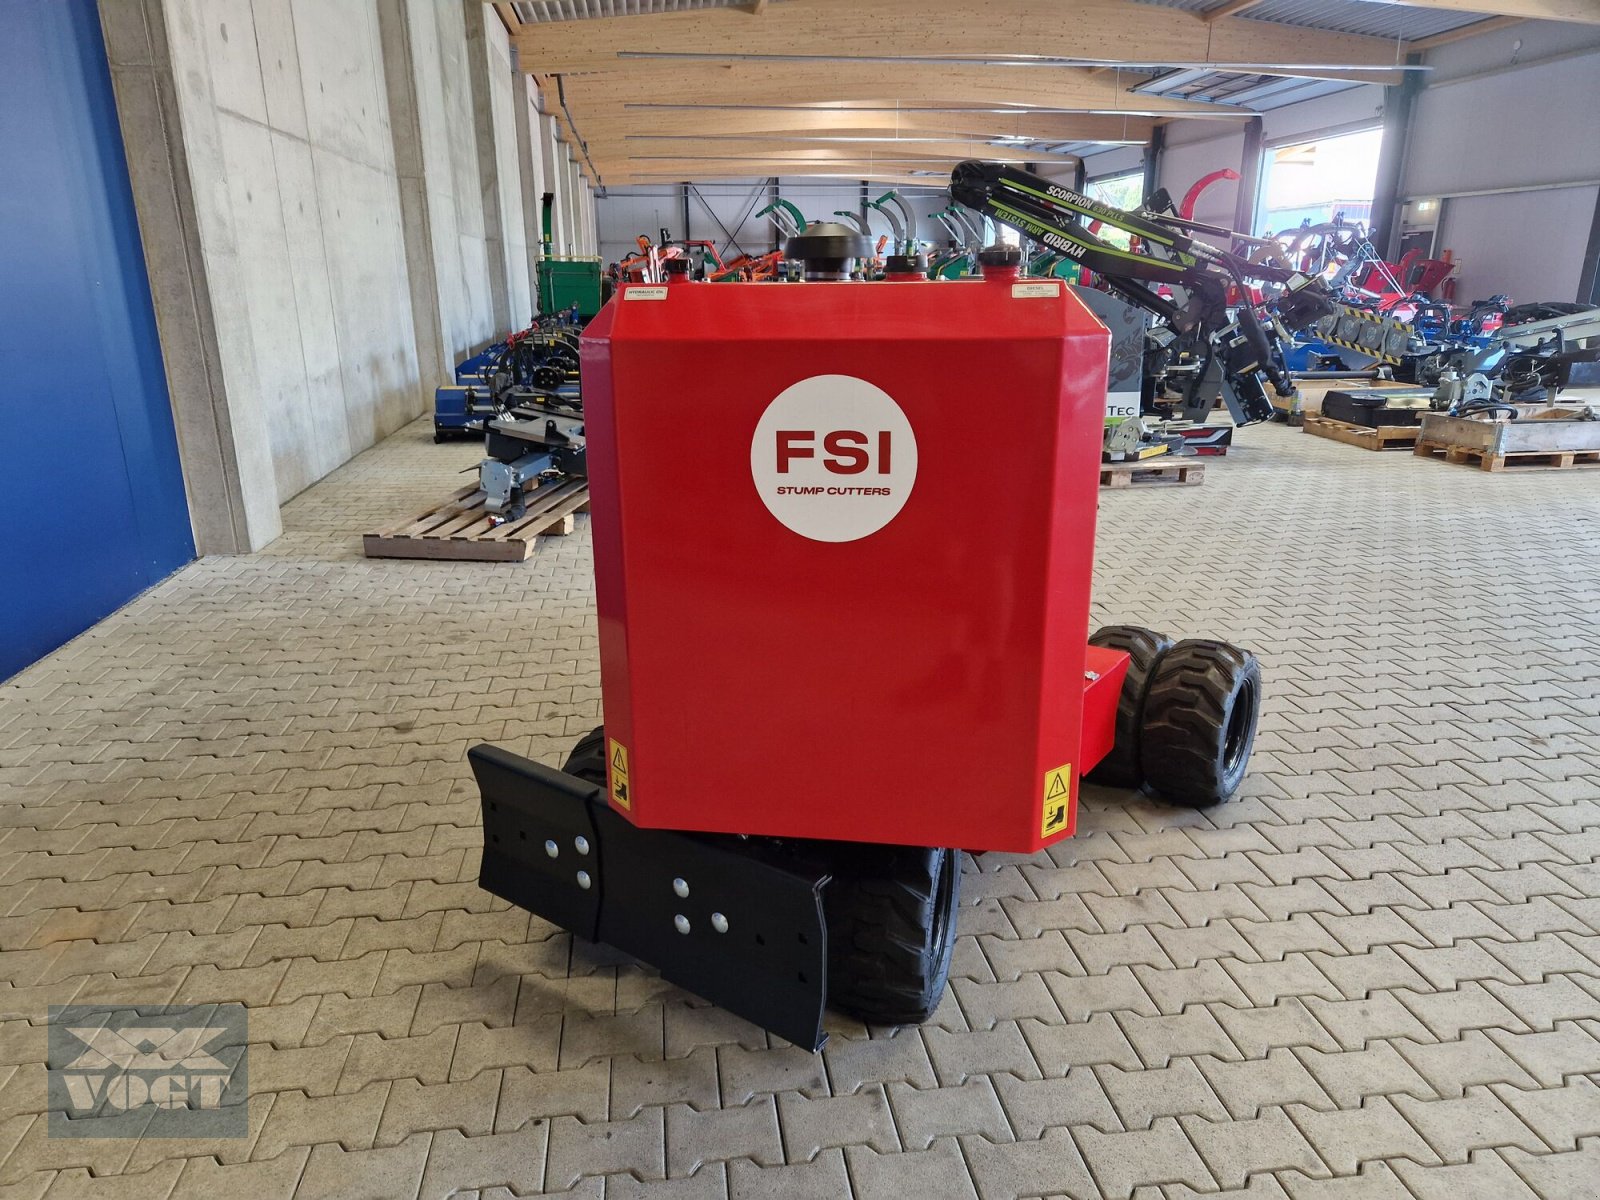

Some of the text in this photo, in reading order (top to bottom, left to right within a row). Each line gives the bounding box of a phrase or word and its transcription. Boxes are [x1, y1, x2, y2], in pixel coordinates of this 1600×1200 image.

[1046, 185, 1094, 209] SCORPION
[994, 208, 1087, 258] HYBRID ARM SYSTEM
[776, 430, 892, 475] FSI
[776, 486, 891, 496] STUMP CUTTERS
